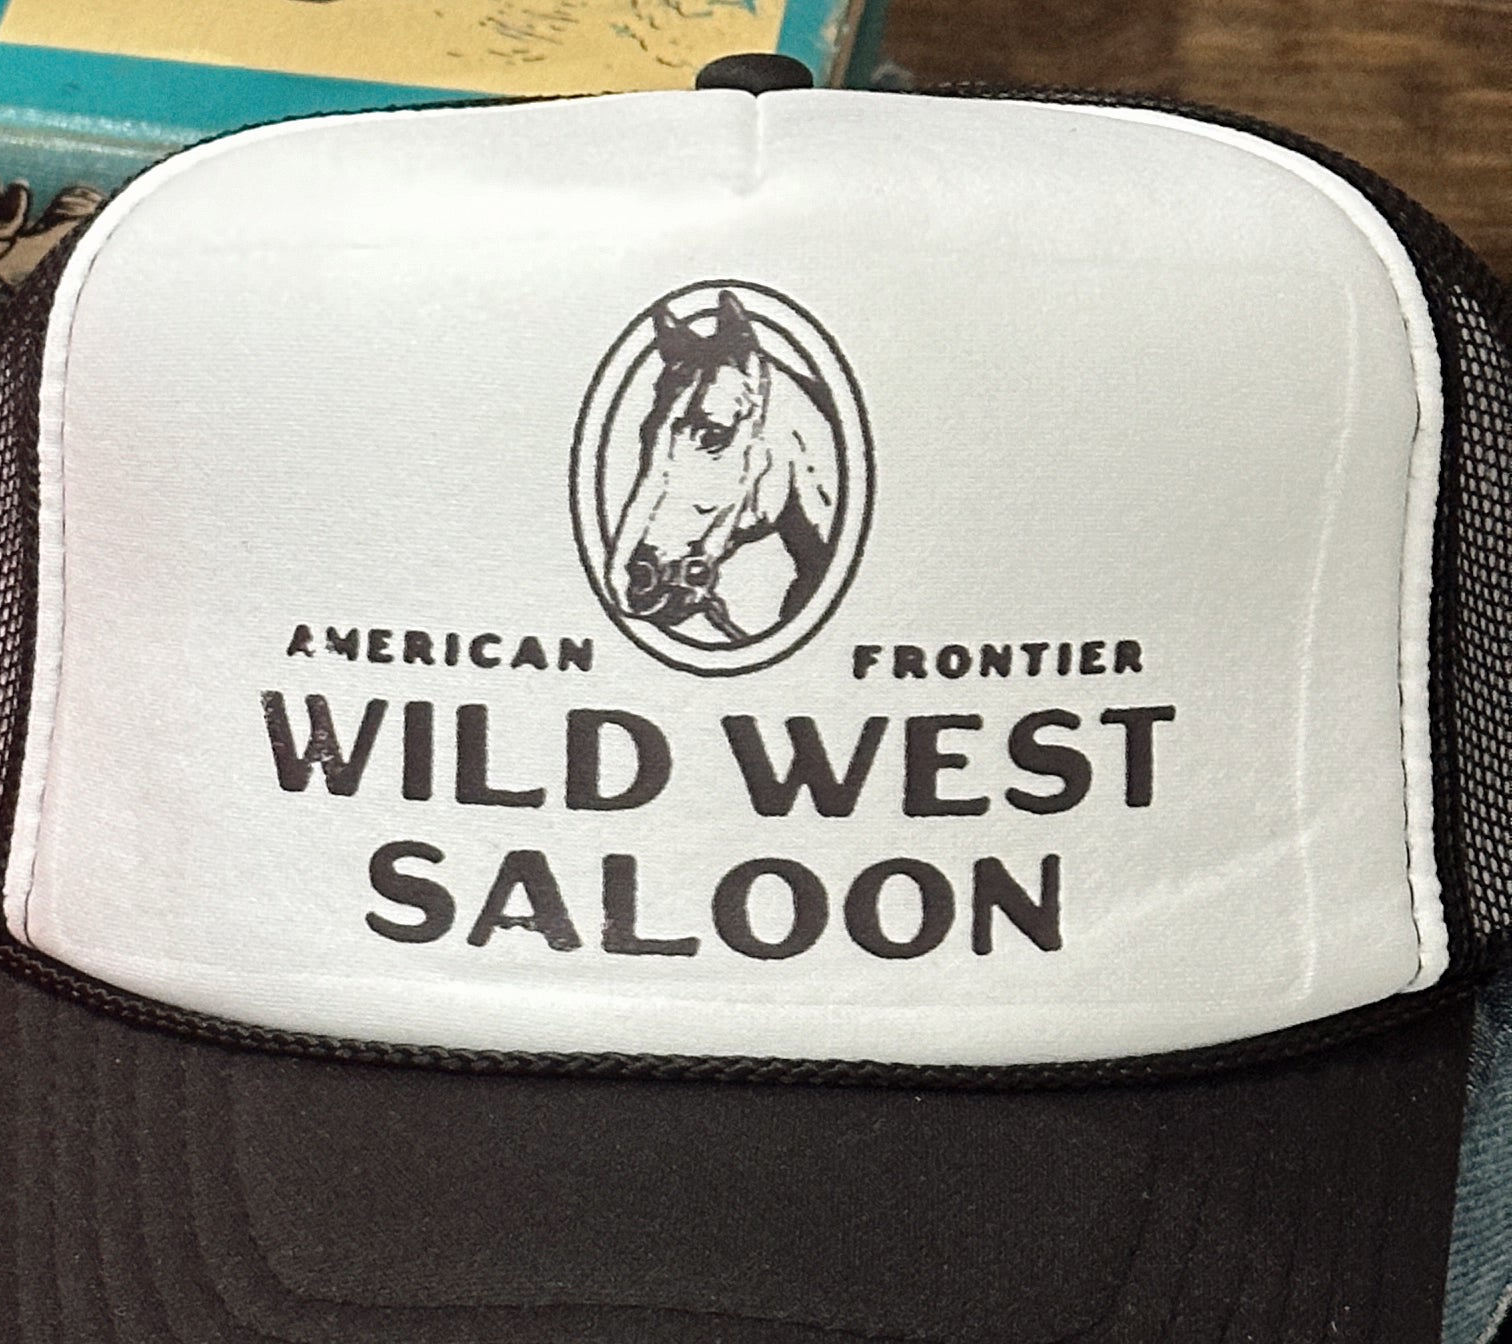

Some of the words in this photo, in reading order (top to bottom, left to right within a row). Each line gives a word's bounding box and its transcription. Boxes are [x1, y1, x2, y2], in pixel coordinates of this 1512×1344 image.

[285, 623, 594, 673] AMERICAN
[851, 638, 1144, 681] FRONTIER
[260, 689, 673, 813] WILD
[719, 703, 1177, 819] WEST
[364, 839, 1063, 962] SALOON
